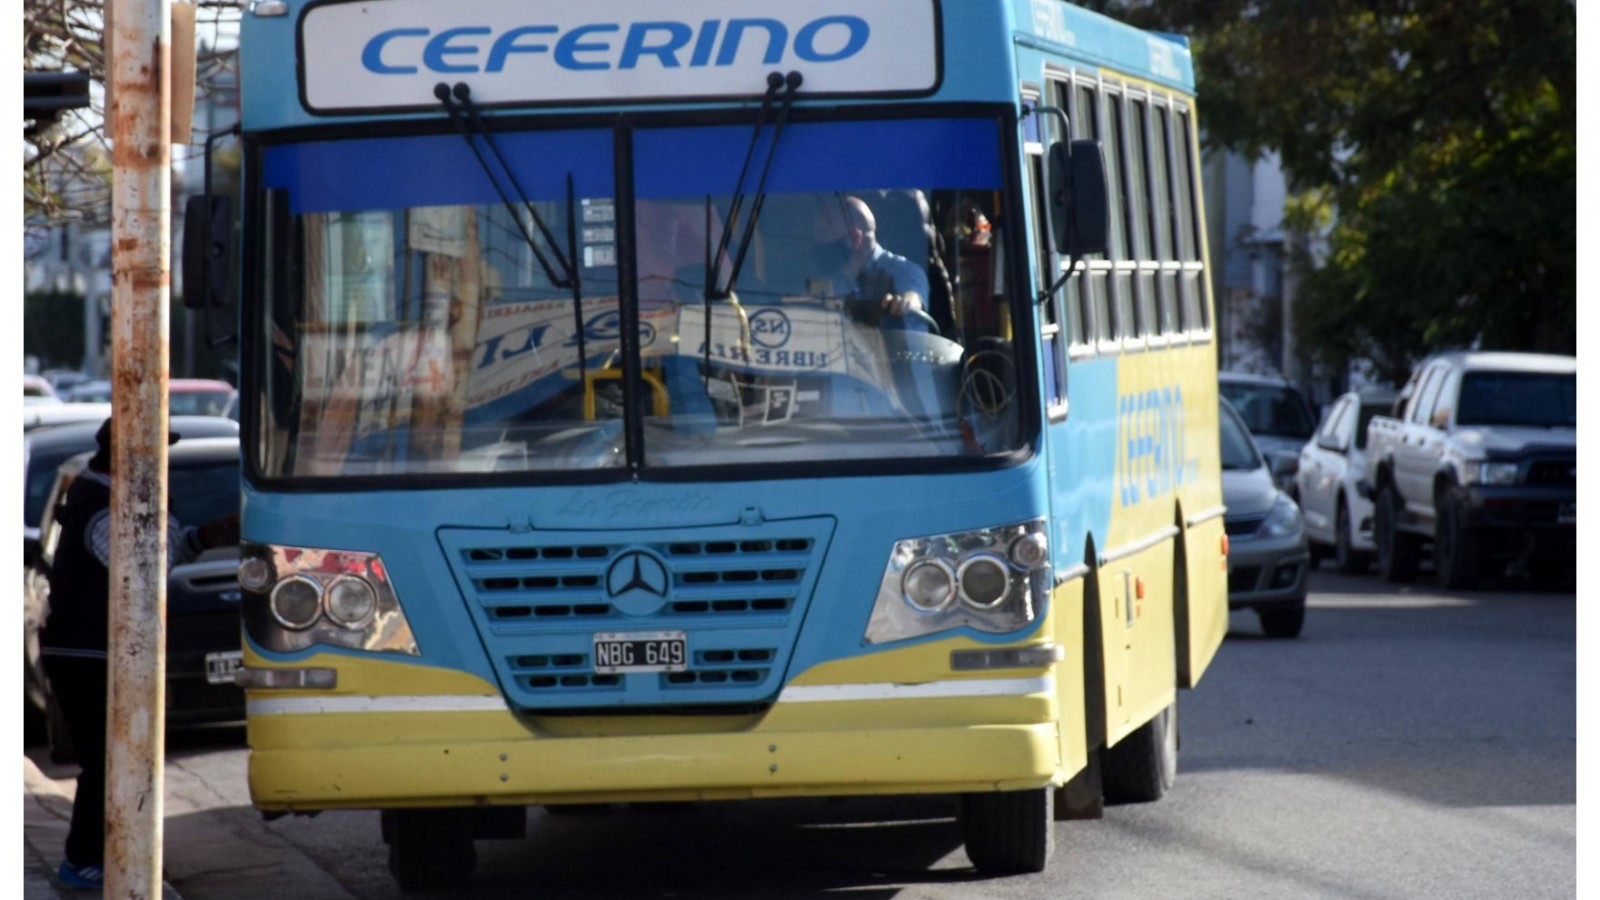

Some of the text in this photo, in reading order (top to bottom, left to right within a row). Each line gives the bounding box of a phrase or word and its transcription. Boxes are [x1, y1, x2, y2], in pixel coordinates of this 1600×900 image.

[361, 14, 870, 75] CEFERINO
[597, 641, 683, 666] NBG 649
